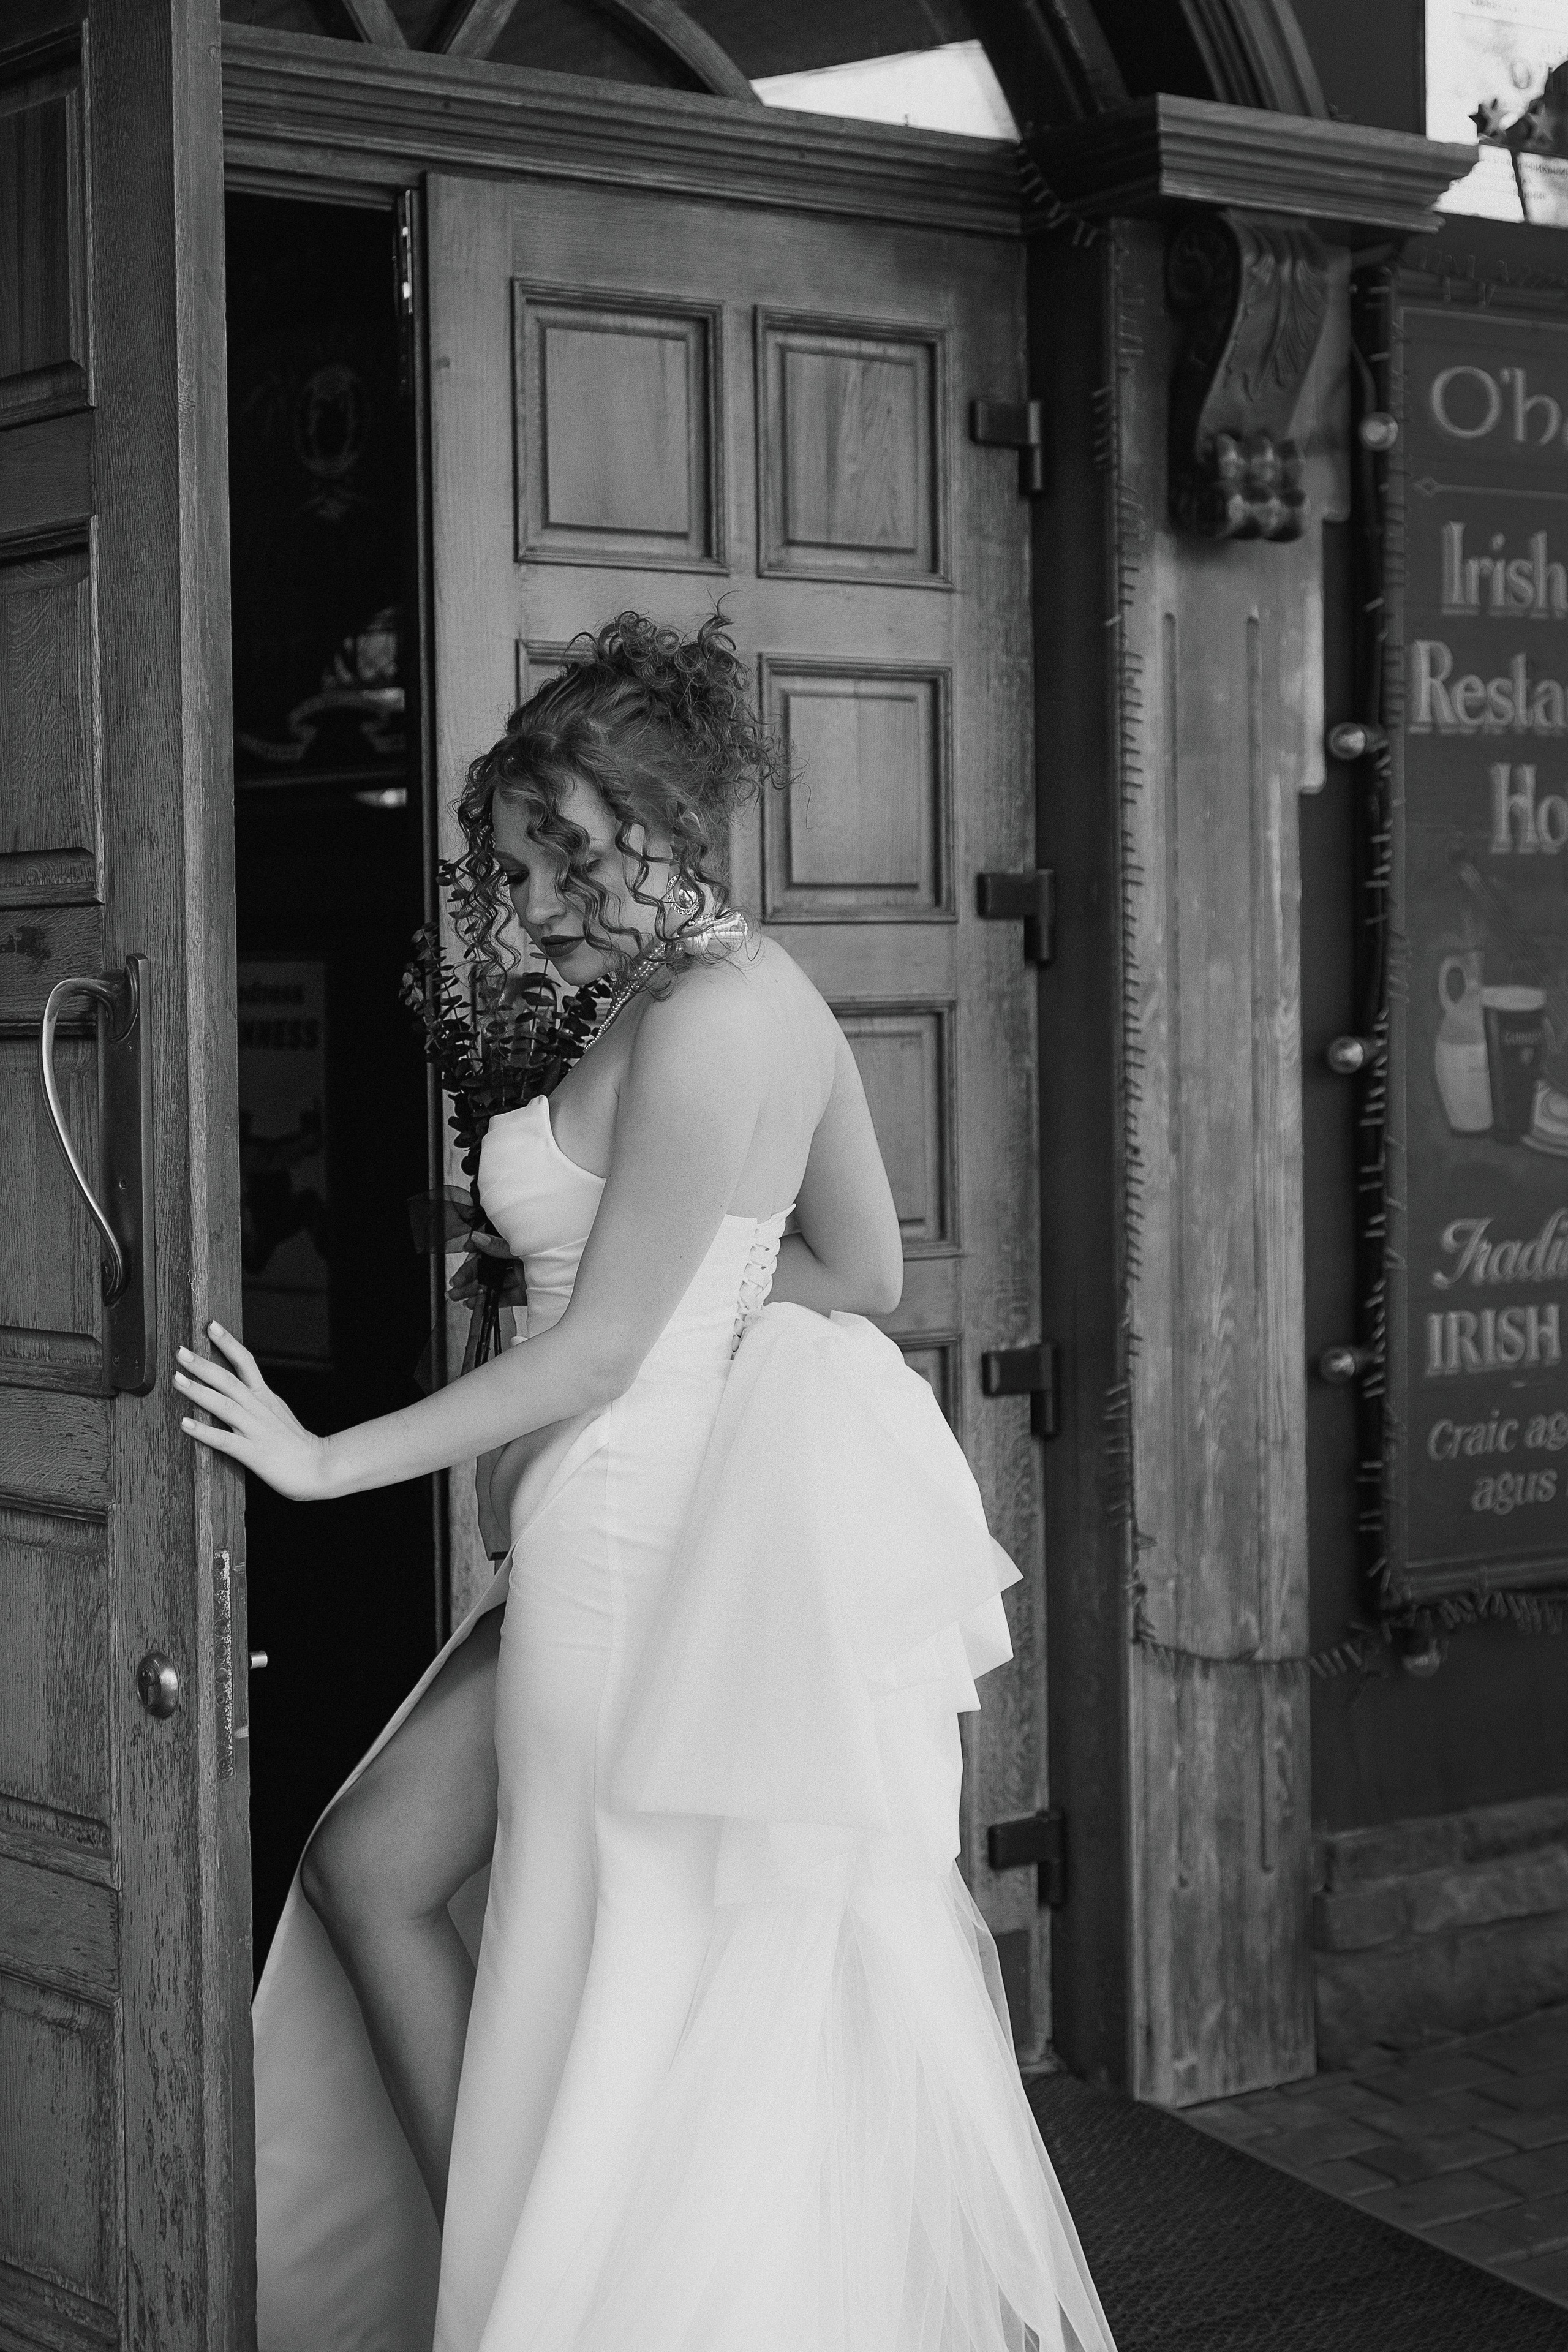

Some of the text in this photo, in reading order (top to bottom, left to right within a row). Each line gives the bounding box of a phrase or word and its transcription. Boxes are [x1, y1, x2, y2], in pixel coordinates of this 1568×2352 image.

[1430, 364, 1568, 448] O'h
[1441, 520, 1568, 620] Irish
[1409, 639, 1568, 735] Resta
[239, 1016, 319, 1049] NNESS
[1425, 1303, 1562, 1377] IRISH
[1427, 1408, 1520, 1460] Craic
[1472, 1469, 1558, 1515] agus
